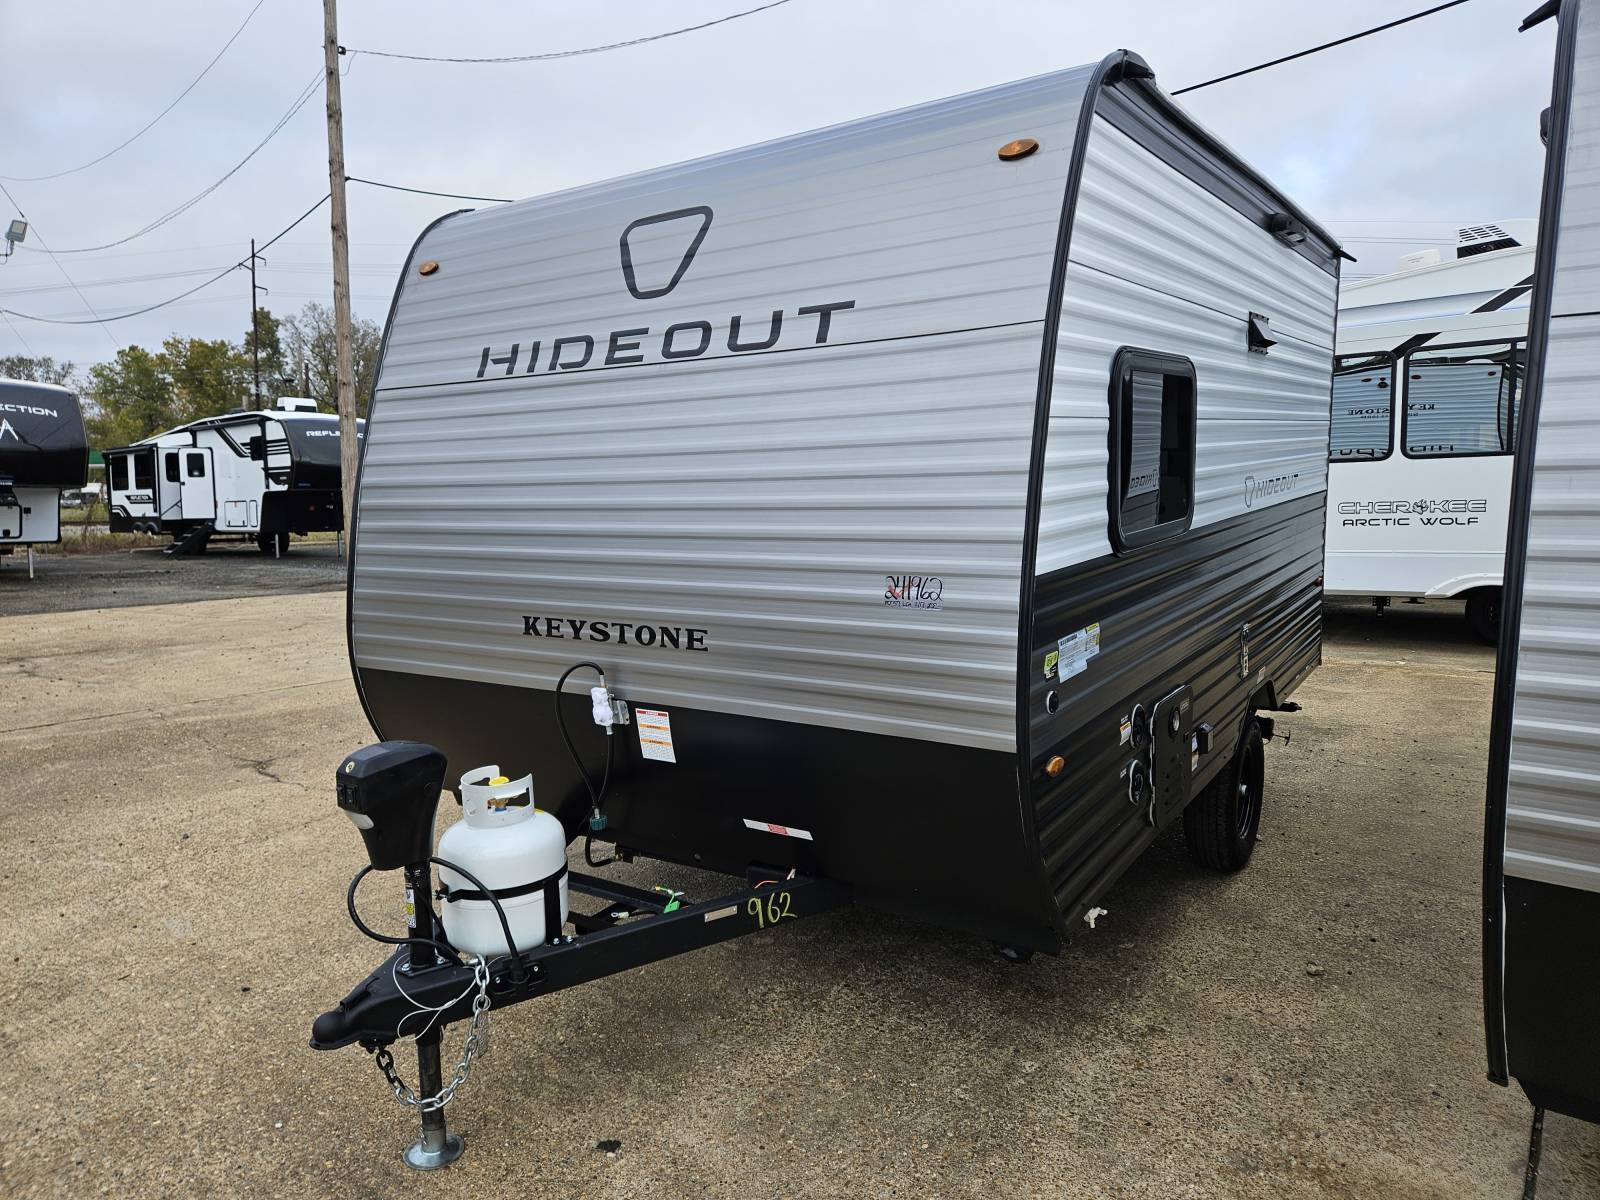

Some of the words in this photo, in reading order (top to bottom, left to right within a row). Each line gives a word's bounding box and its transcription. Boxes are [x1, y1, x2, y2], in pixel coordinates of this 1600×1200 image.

[475, 300, 856, 378] HIDEOUT
[1255, 474, 1299, 498] HIDEOUT
[1342, 517, 1411, 527] ARCTIC
[1419, 517, 1479, 526] WOLF
[884, 575, 943, 601] 241962
[521, 615, 709, 652] KEYSTONE
[747, 892, 798, 929] 962
